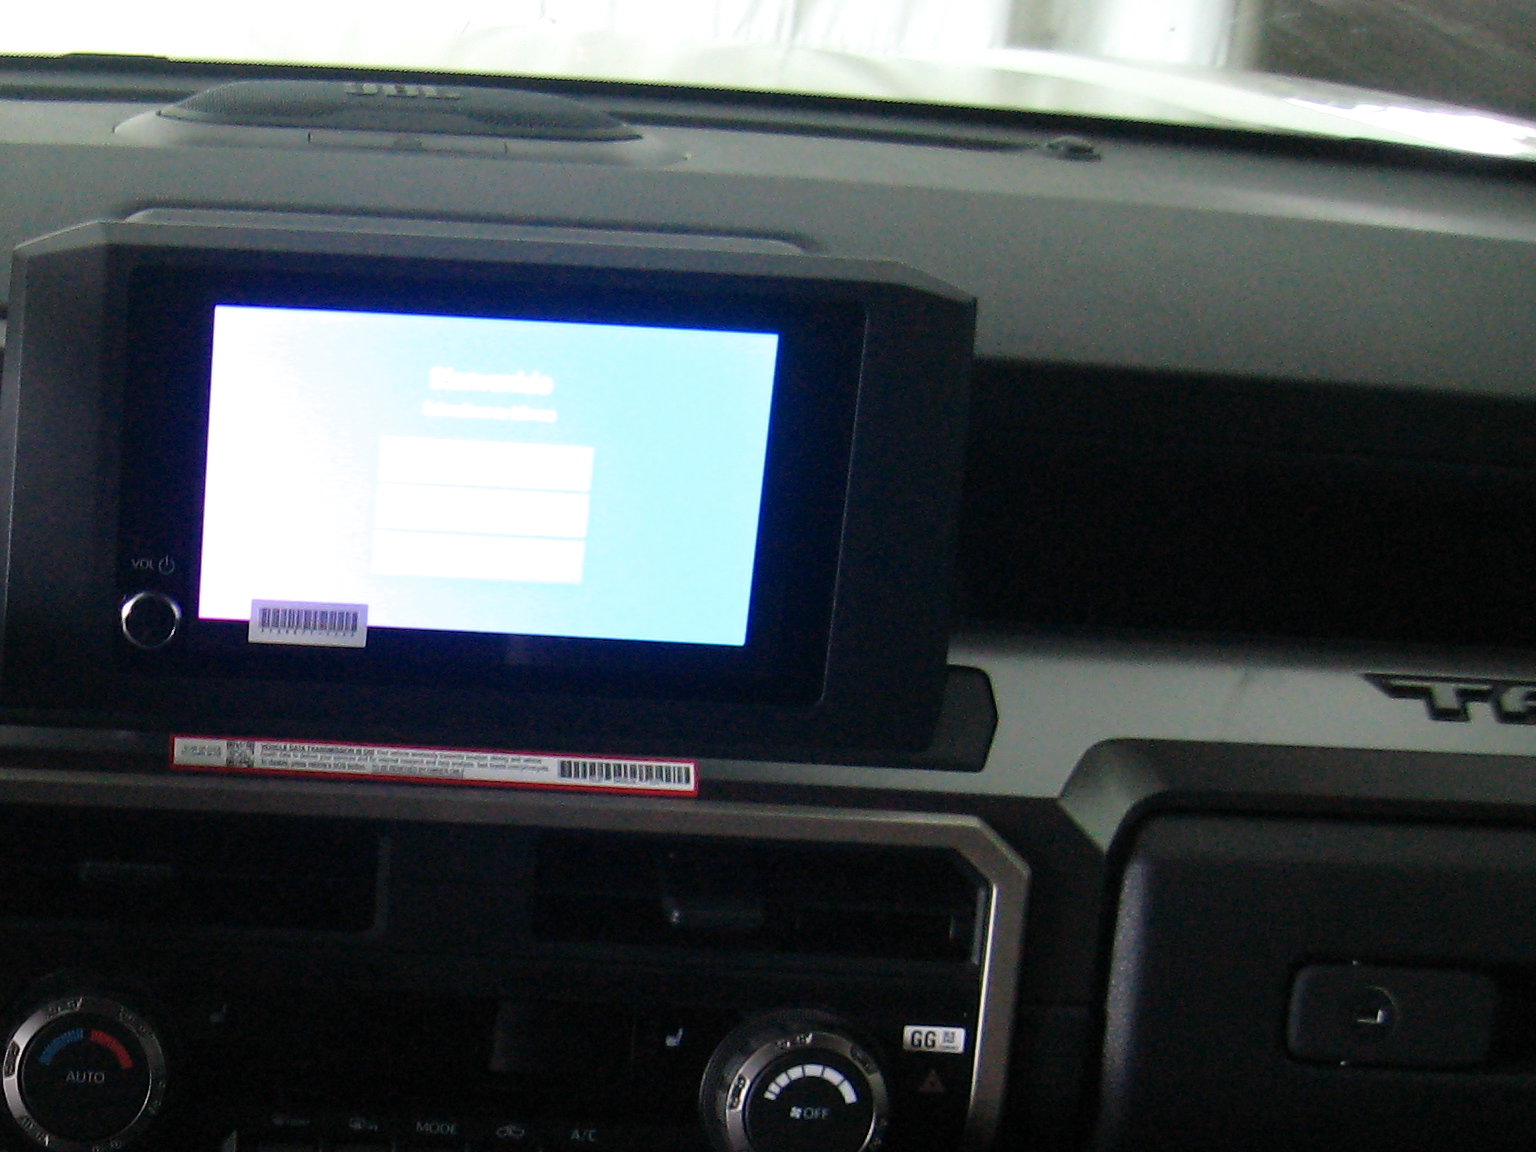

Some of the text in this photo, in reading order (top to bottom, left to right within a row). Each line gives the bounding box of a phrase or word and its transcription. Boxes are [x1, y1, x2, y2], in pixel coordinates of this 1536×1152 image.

[131, 558, 154, 570] VOL
[911, 1031, 936, 1048] GG
[65, 1071, 105, 1084] AUTO
[803, 1107, 831, 1120] OFF
[415, 1120, 457, 1136] MODE
[570, 1128, 597, 1143] A/C
